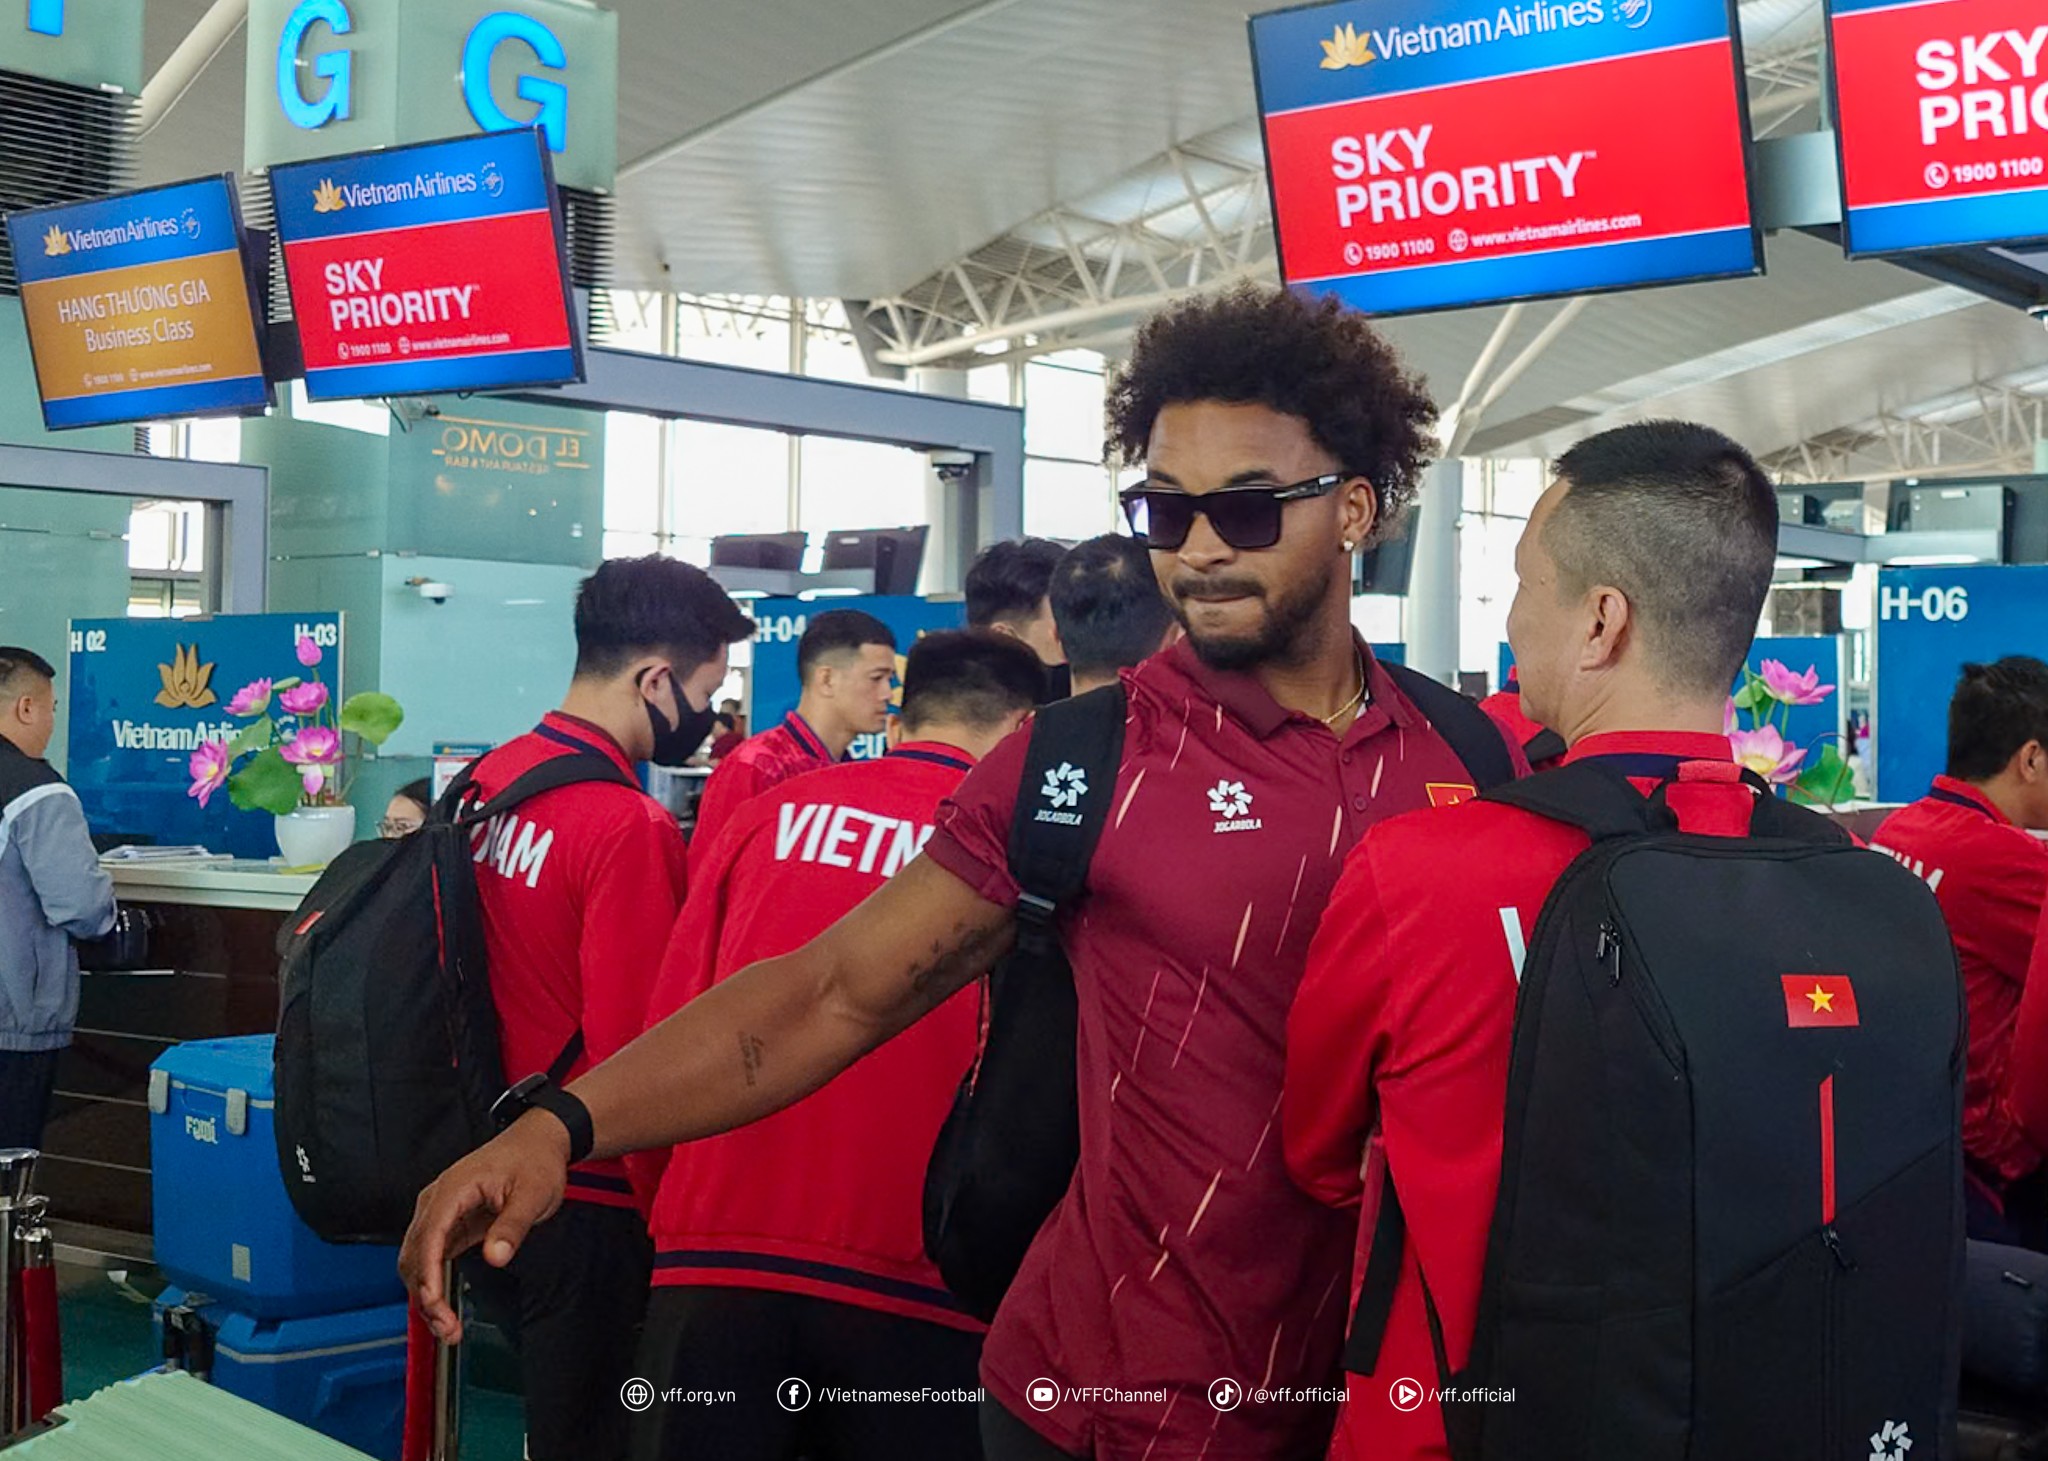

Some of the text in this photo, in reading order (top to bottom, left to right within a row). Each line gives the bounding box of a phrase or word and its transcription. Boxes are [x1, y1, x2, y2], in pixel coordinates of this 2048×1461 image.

[277, 0, 350, 130] G
[1915, 25, 2048, 90] SKY
[462, 11, 568, 153] G
[1331, 124, 1434, 180] SKY
[1952, 157, 2044, 183] 1900 1100
[1336, 152, 1583, 228] PRIORITY
[1365, 213, 1642, 261] 1900 1100 www.vietnamairlines.com
[179, 279, 211, 306] GIA
[325, 258, 383, 295] SKY
[330, 284, 473, 331] PRIORITY
[84, 317, 194, 353] Business Class
[1881, 586, 1969, 621] H-06
[294, 623, 338, 647] H-03
[775, 802, 936, 879] VIETN
